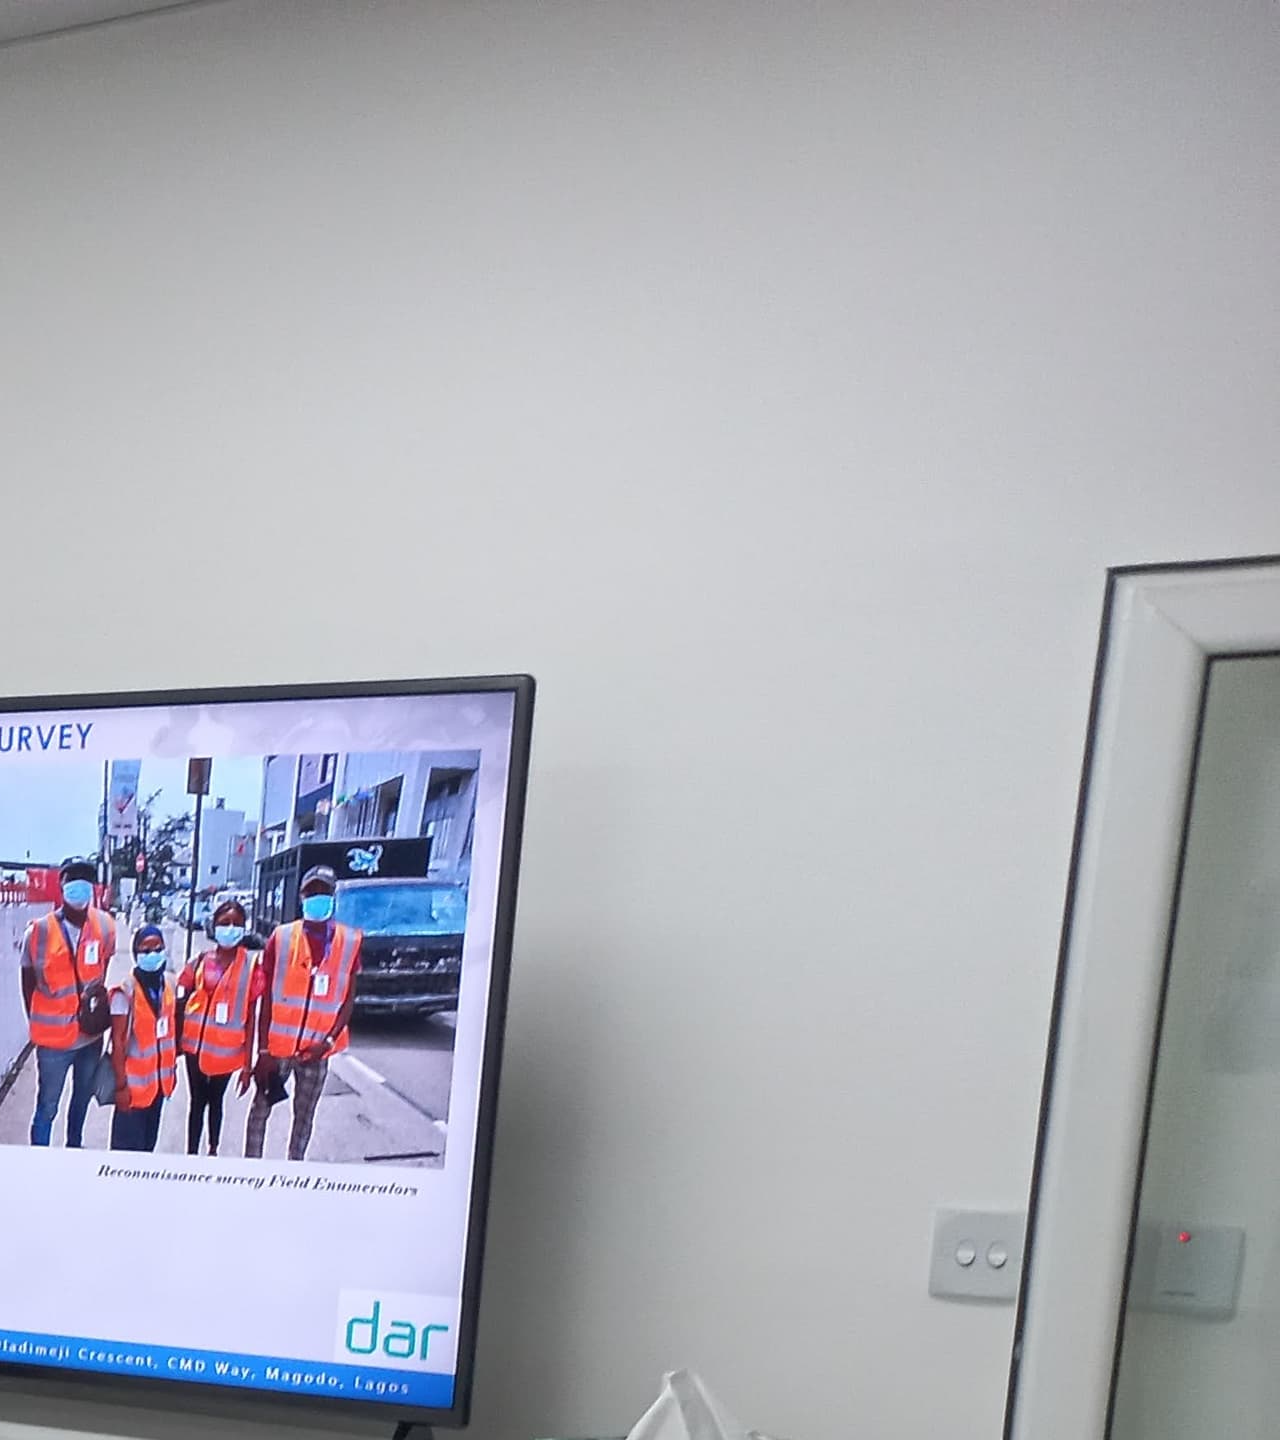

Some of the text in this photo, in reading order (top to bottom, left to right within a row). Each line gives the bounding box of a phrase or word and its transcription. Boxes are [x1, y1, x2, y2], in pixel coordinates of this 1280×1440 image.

[96, 1164, 418, 1196] Reconnaissance survey Field Enumerators
[345, 1300, 449, 1361] dar
[78, 1348, 159, 1369] Crescent,
[168, 1356, 206, 1373] CMD
[215, 1362, 257, 1380] Way,
[265, 1366, 344, 1389] Magodo,
[354, 1376, 409, 1395] Lagos
